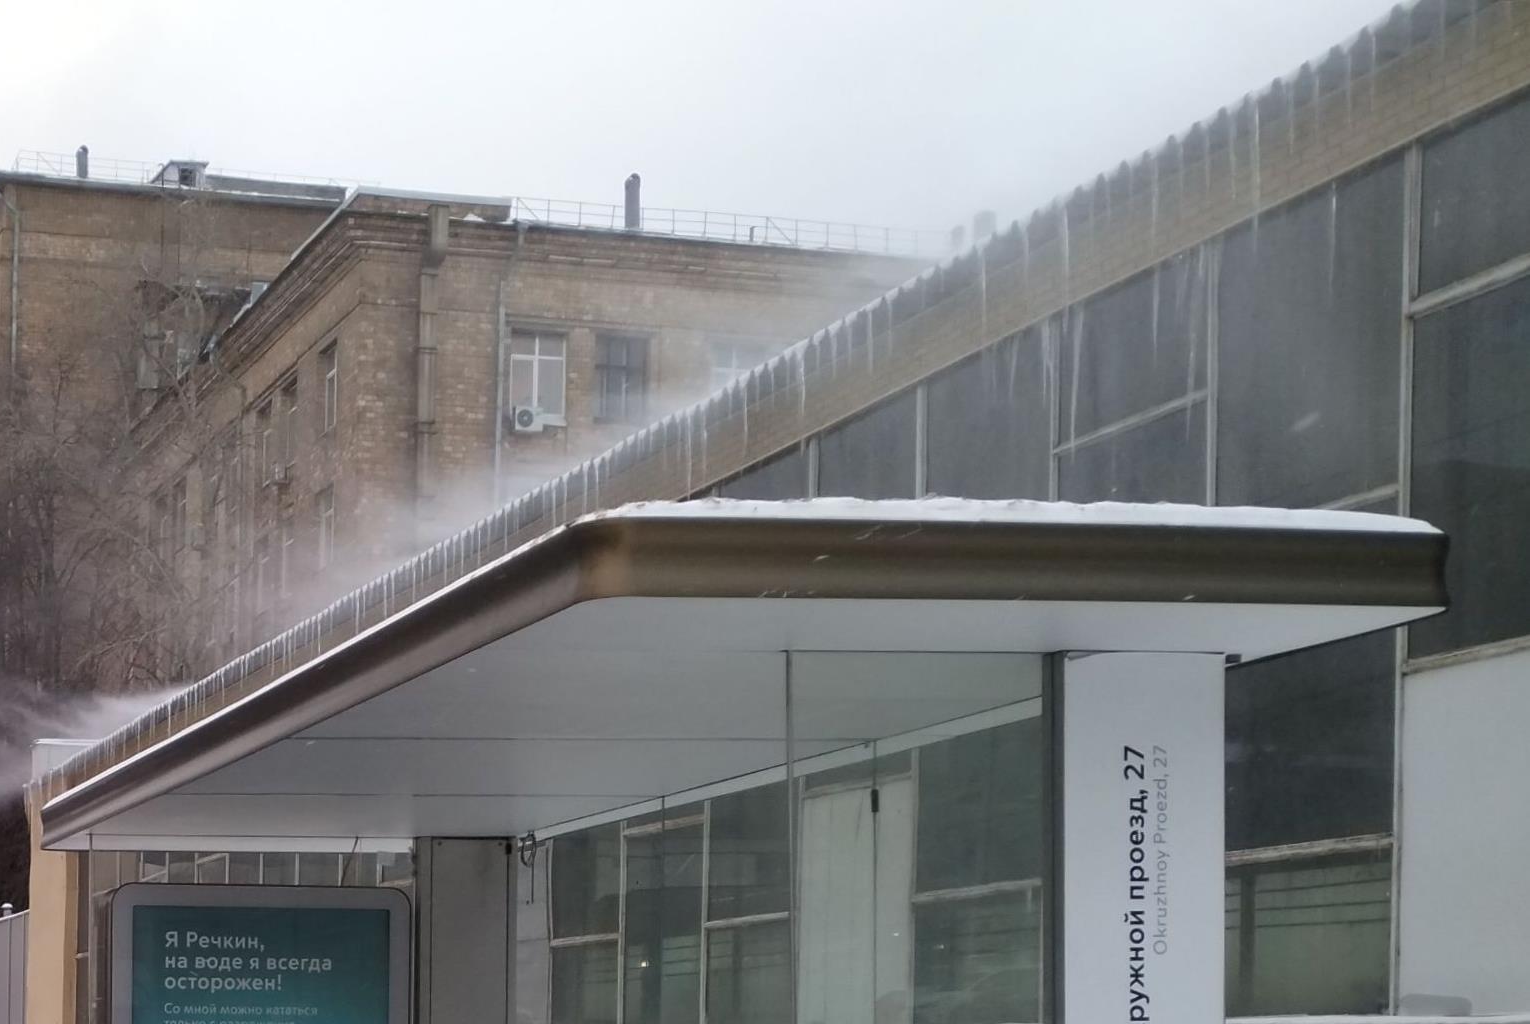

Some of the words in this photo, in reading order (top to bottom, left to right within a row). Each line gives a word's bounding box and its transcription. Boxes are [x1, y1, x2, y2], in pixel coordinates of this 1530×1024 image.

[1124, 745, 1145, 780] 27
[1153, 744, 1168, 768] 27
[1153, 773, 1170, 844] Proezd,
[1129, 790, 1150, 900] проезд,
[1153, 850, 1171, 956] Okruzhnoy
[165, 931, 178, 948] Я
[186, 931, 265, 951] Речкин,
[164, 956, 188, 969] на
[195, 956, 243, 972] воде
[249, 958, 259, 970] я
[267, 957, 332, 973] всегда
[164, 974, 282, 993] осторожен!
[164, 1002, 181, 1015] Со
[184, 1003, 217, 1015] мной
[221, 1006, 263, 1016] можно
[266, 1006, 318, 1016] кататься
